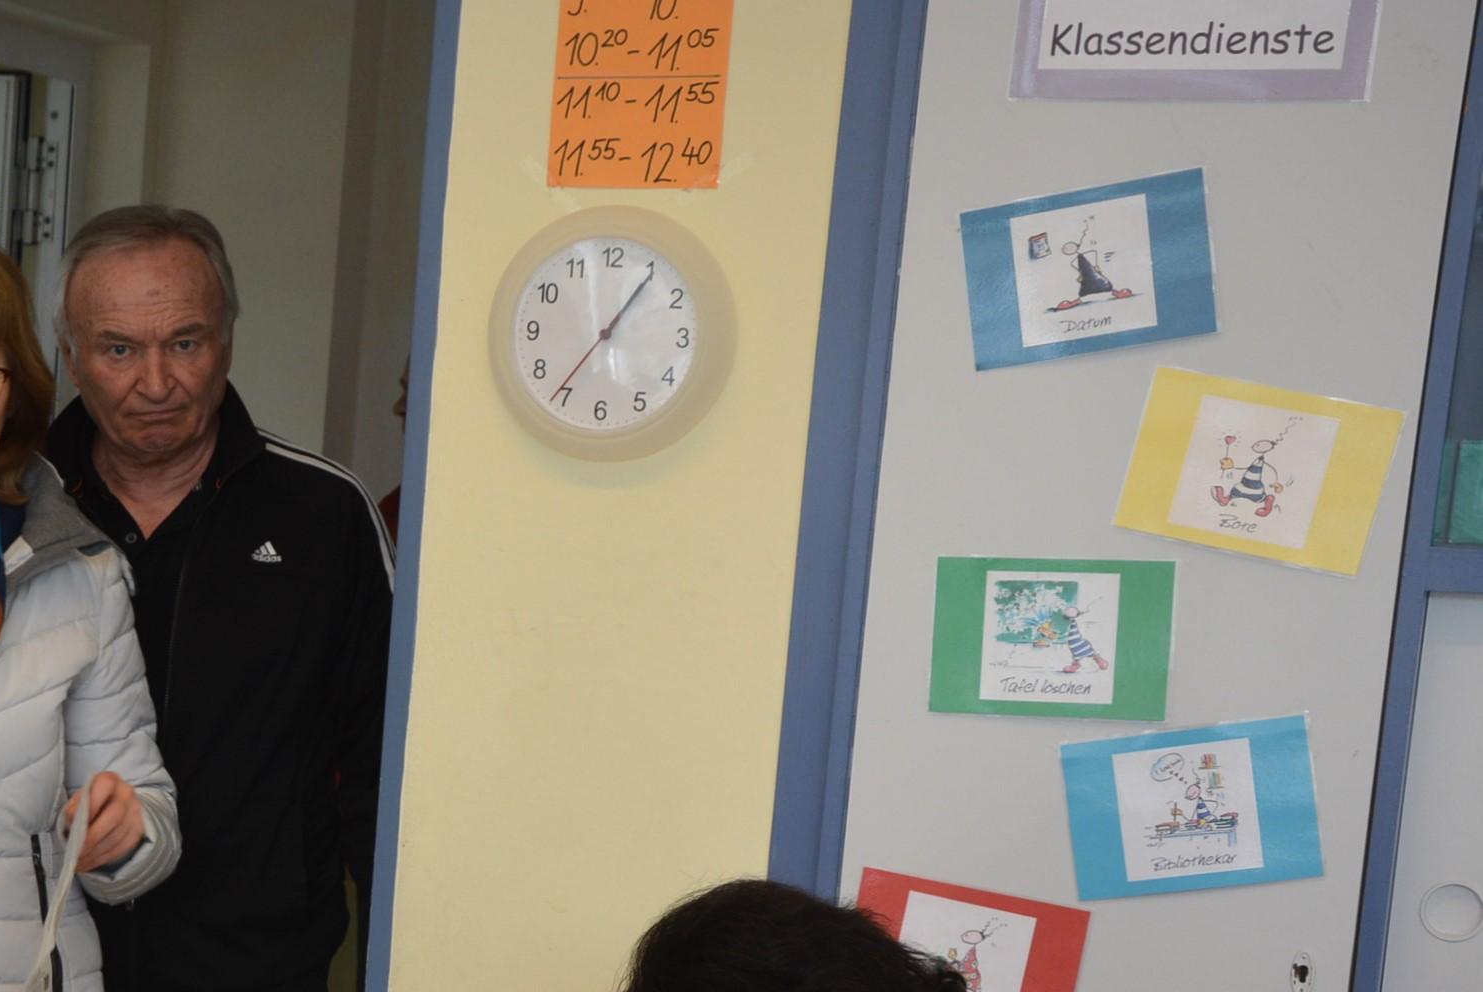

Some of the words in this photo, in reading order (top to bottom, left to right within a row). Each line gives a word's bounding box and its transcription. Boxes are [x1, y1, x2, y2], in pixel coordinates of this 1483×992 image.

[1050, 21, 1336, 57] Klassendienste
[602, 247, 624, 268] 12
[566, 258, 585, 278] 11
[645, 261, 655, 280] 1
[537, 283, 559, 304] 10
[669, 288, 684, 309] 2
[526, 320, 540, 341] 9
[1059, 315, 1112, 334] Datum
[676, 327, 690, 348] 3
[533, 359, 547, 379] 8
[661, 366, 675, 386] 4
[560, 387, 573, 407] 7
[633, 391, 647, 412] 5
[594, 400, 607, 420] 6
[999, 676, 1039, 694] Tafel
[1150, 853, 1238, 872] Bibliothekar
